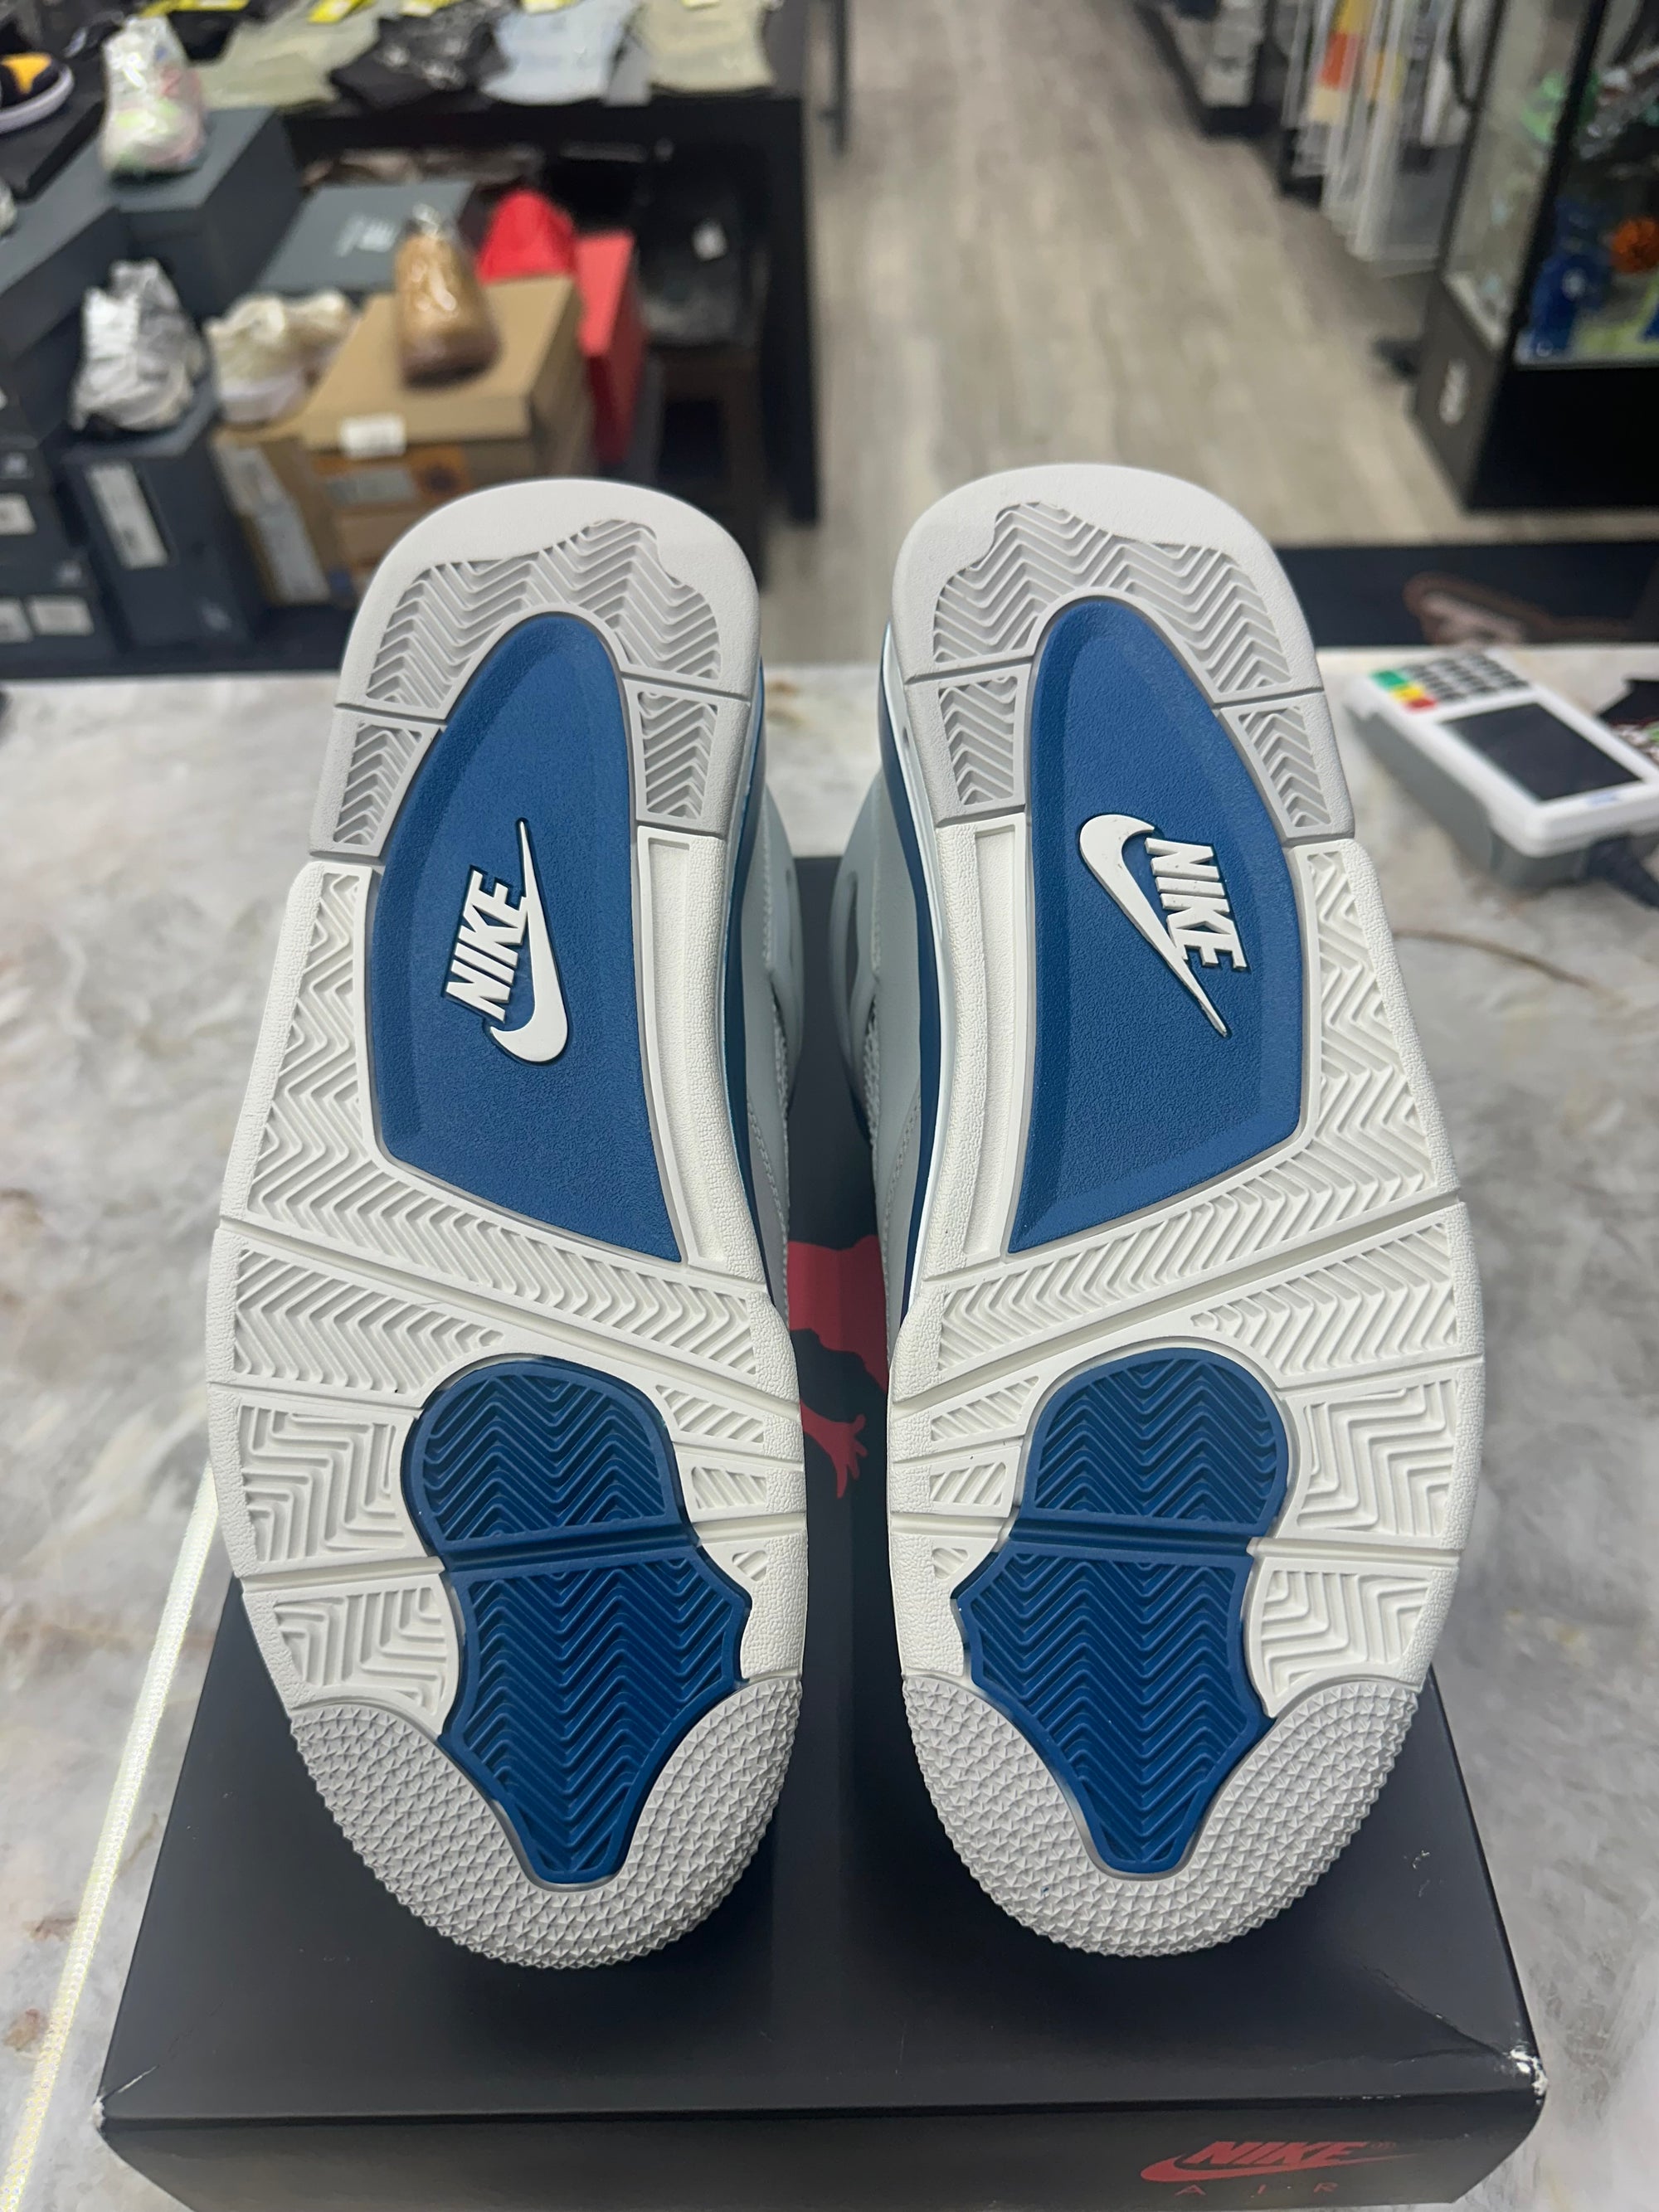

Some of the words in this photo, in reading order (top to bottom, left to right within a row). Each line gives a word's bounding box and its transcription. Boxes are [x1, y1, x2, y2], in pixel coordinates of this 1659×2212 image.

[445, 868, 528, 1023] NIKE
[1144, 836, 1248, 970] NIKE
[1181, 2140, 1369, 2166] NIKE
